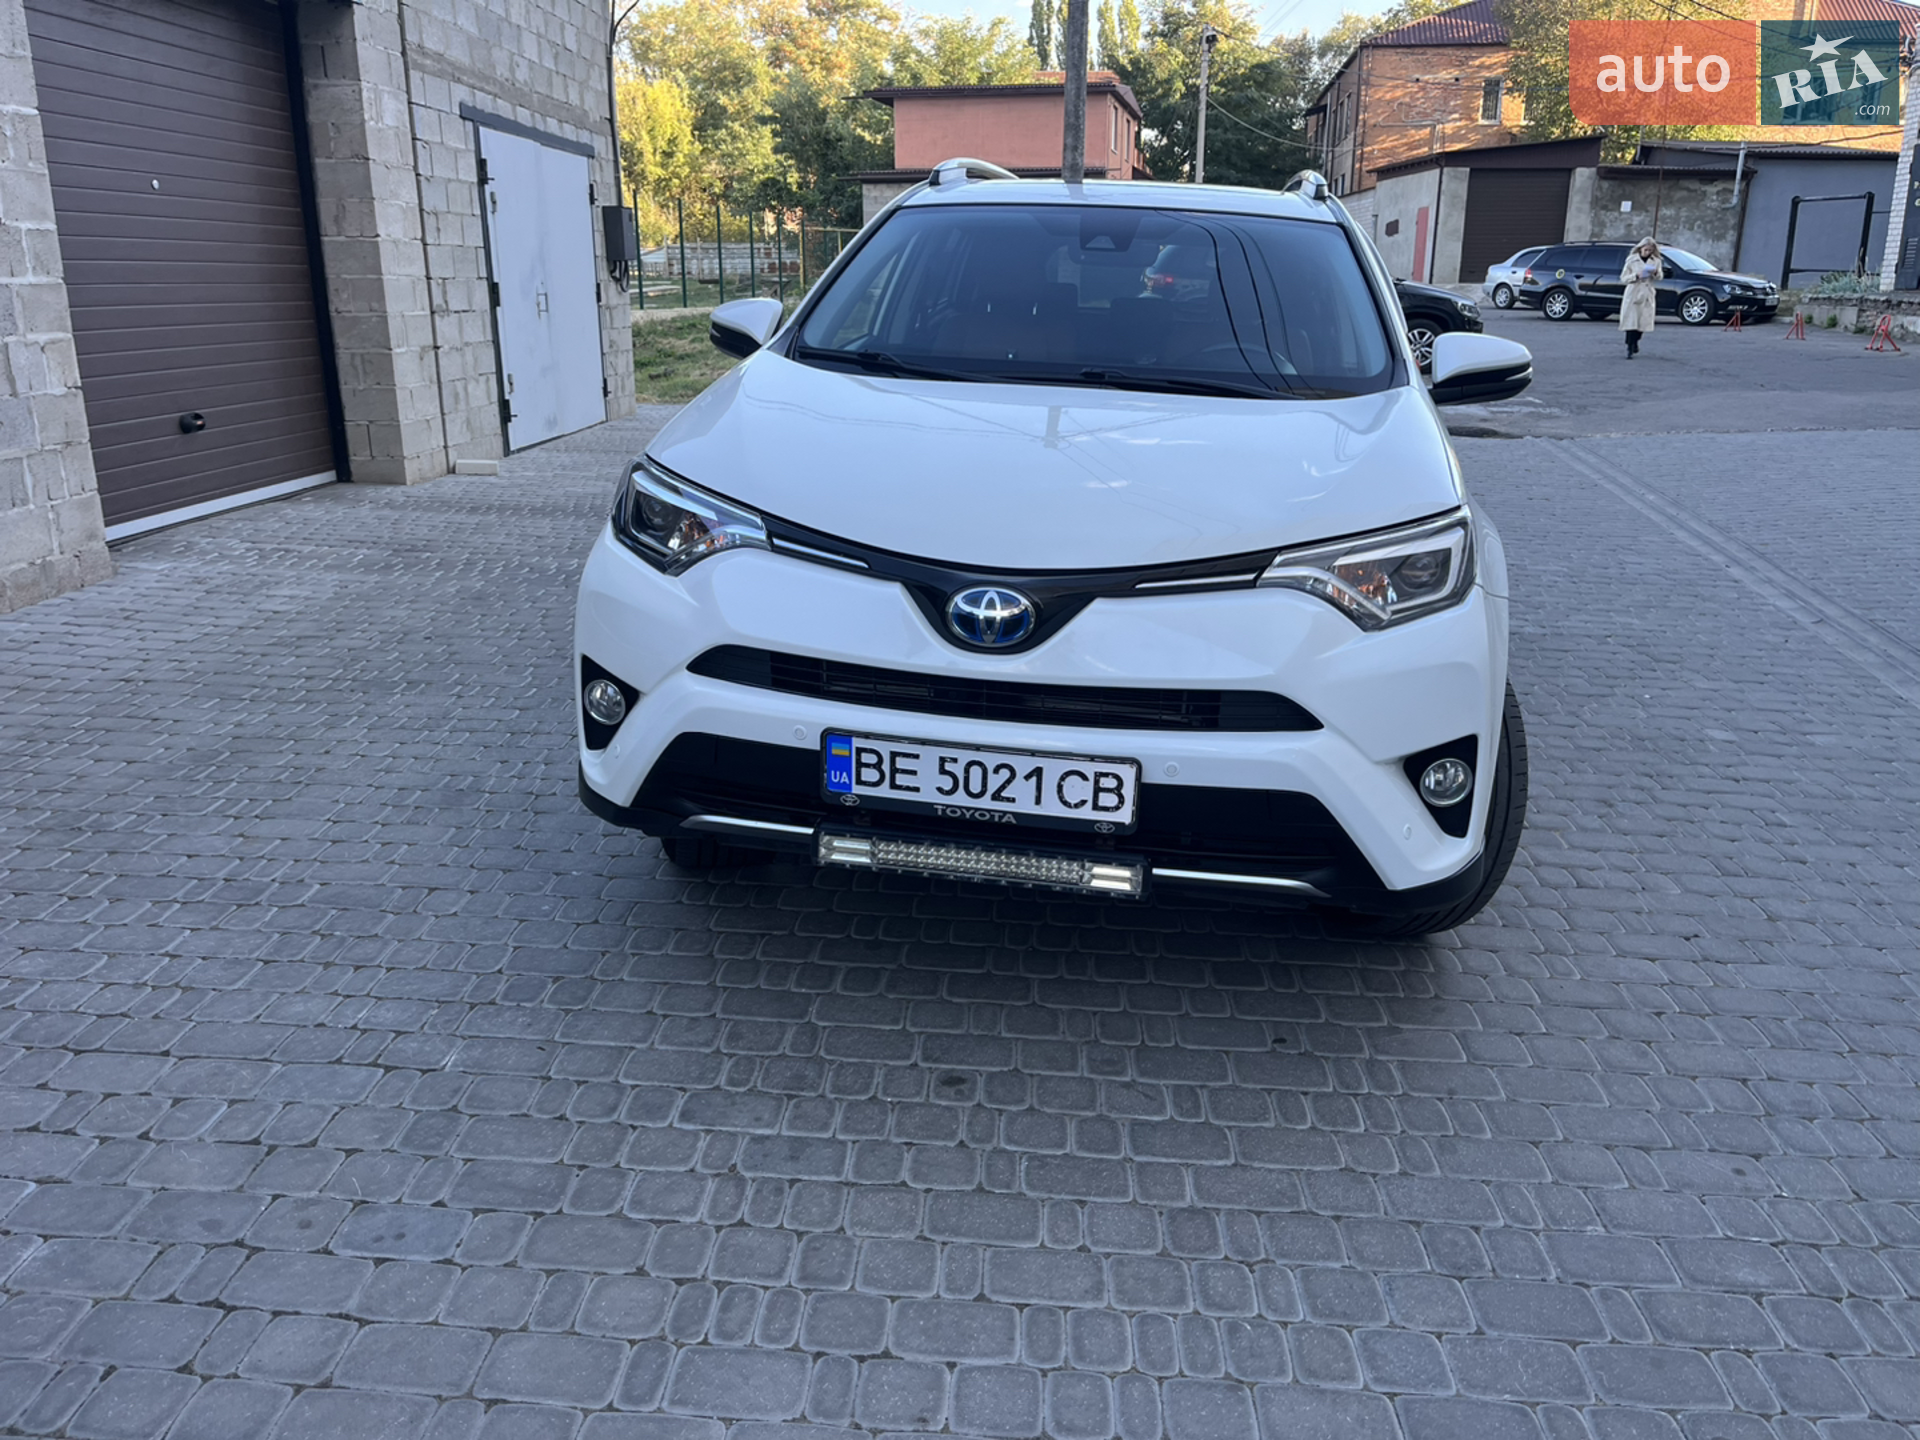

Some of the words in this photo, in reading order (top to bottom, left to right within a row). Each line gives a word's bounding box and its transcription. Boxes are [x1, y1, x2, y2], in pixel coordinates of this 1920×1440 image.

[831, 770, 850, 784] UA
[855, 746, 921, 793] BE
[935, 756, 1044, 806] 5021
[1056, 769, 1126, 813] CB
[933, 804, 1017, 824] TOYOTA
